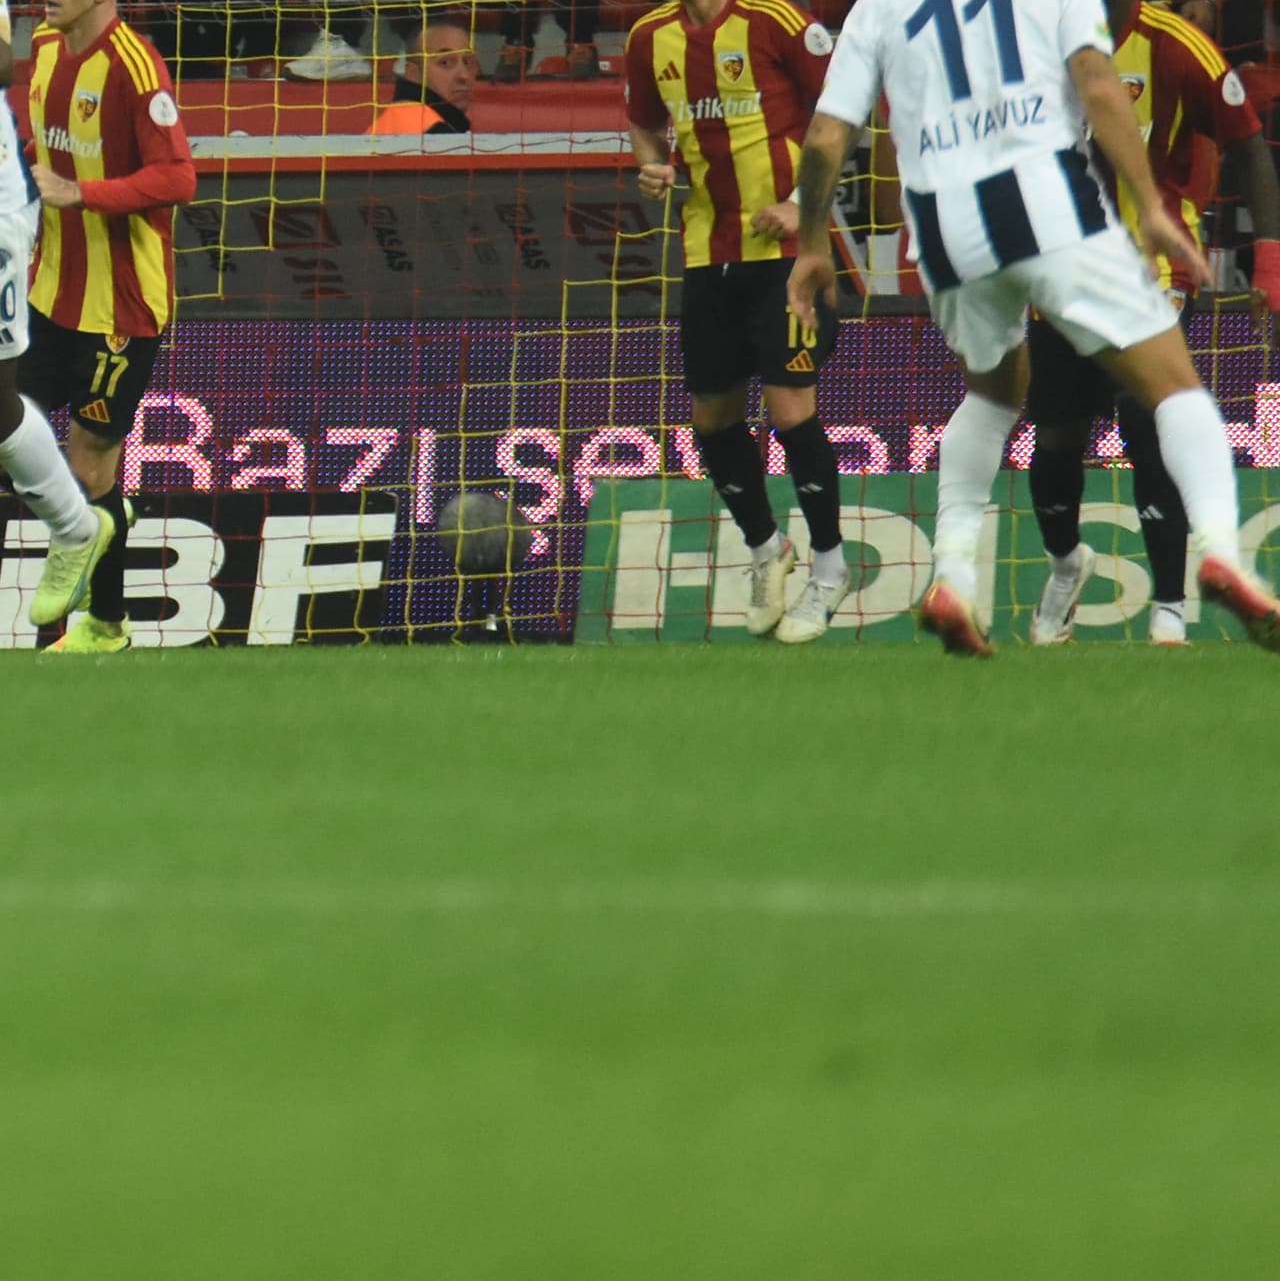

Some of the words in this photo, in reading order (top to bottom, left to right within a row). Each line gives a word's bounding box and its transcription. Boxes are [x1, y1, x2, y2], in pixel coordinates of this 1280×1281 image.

[919, 111, 960, 156] ALİ
[966, 95, 1046, 140] YAVUZ
[90, 350, 130, 399] 17
